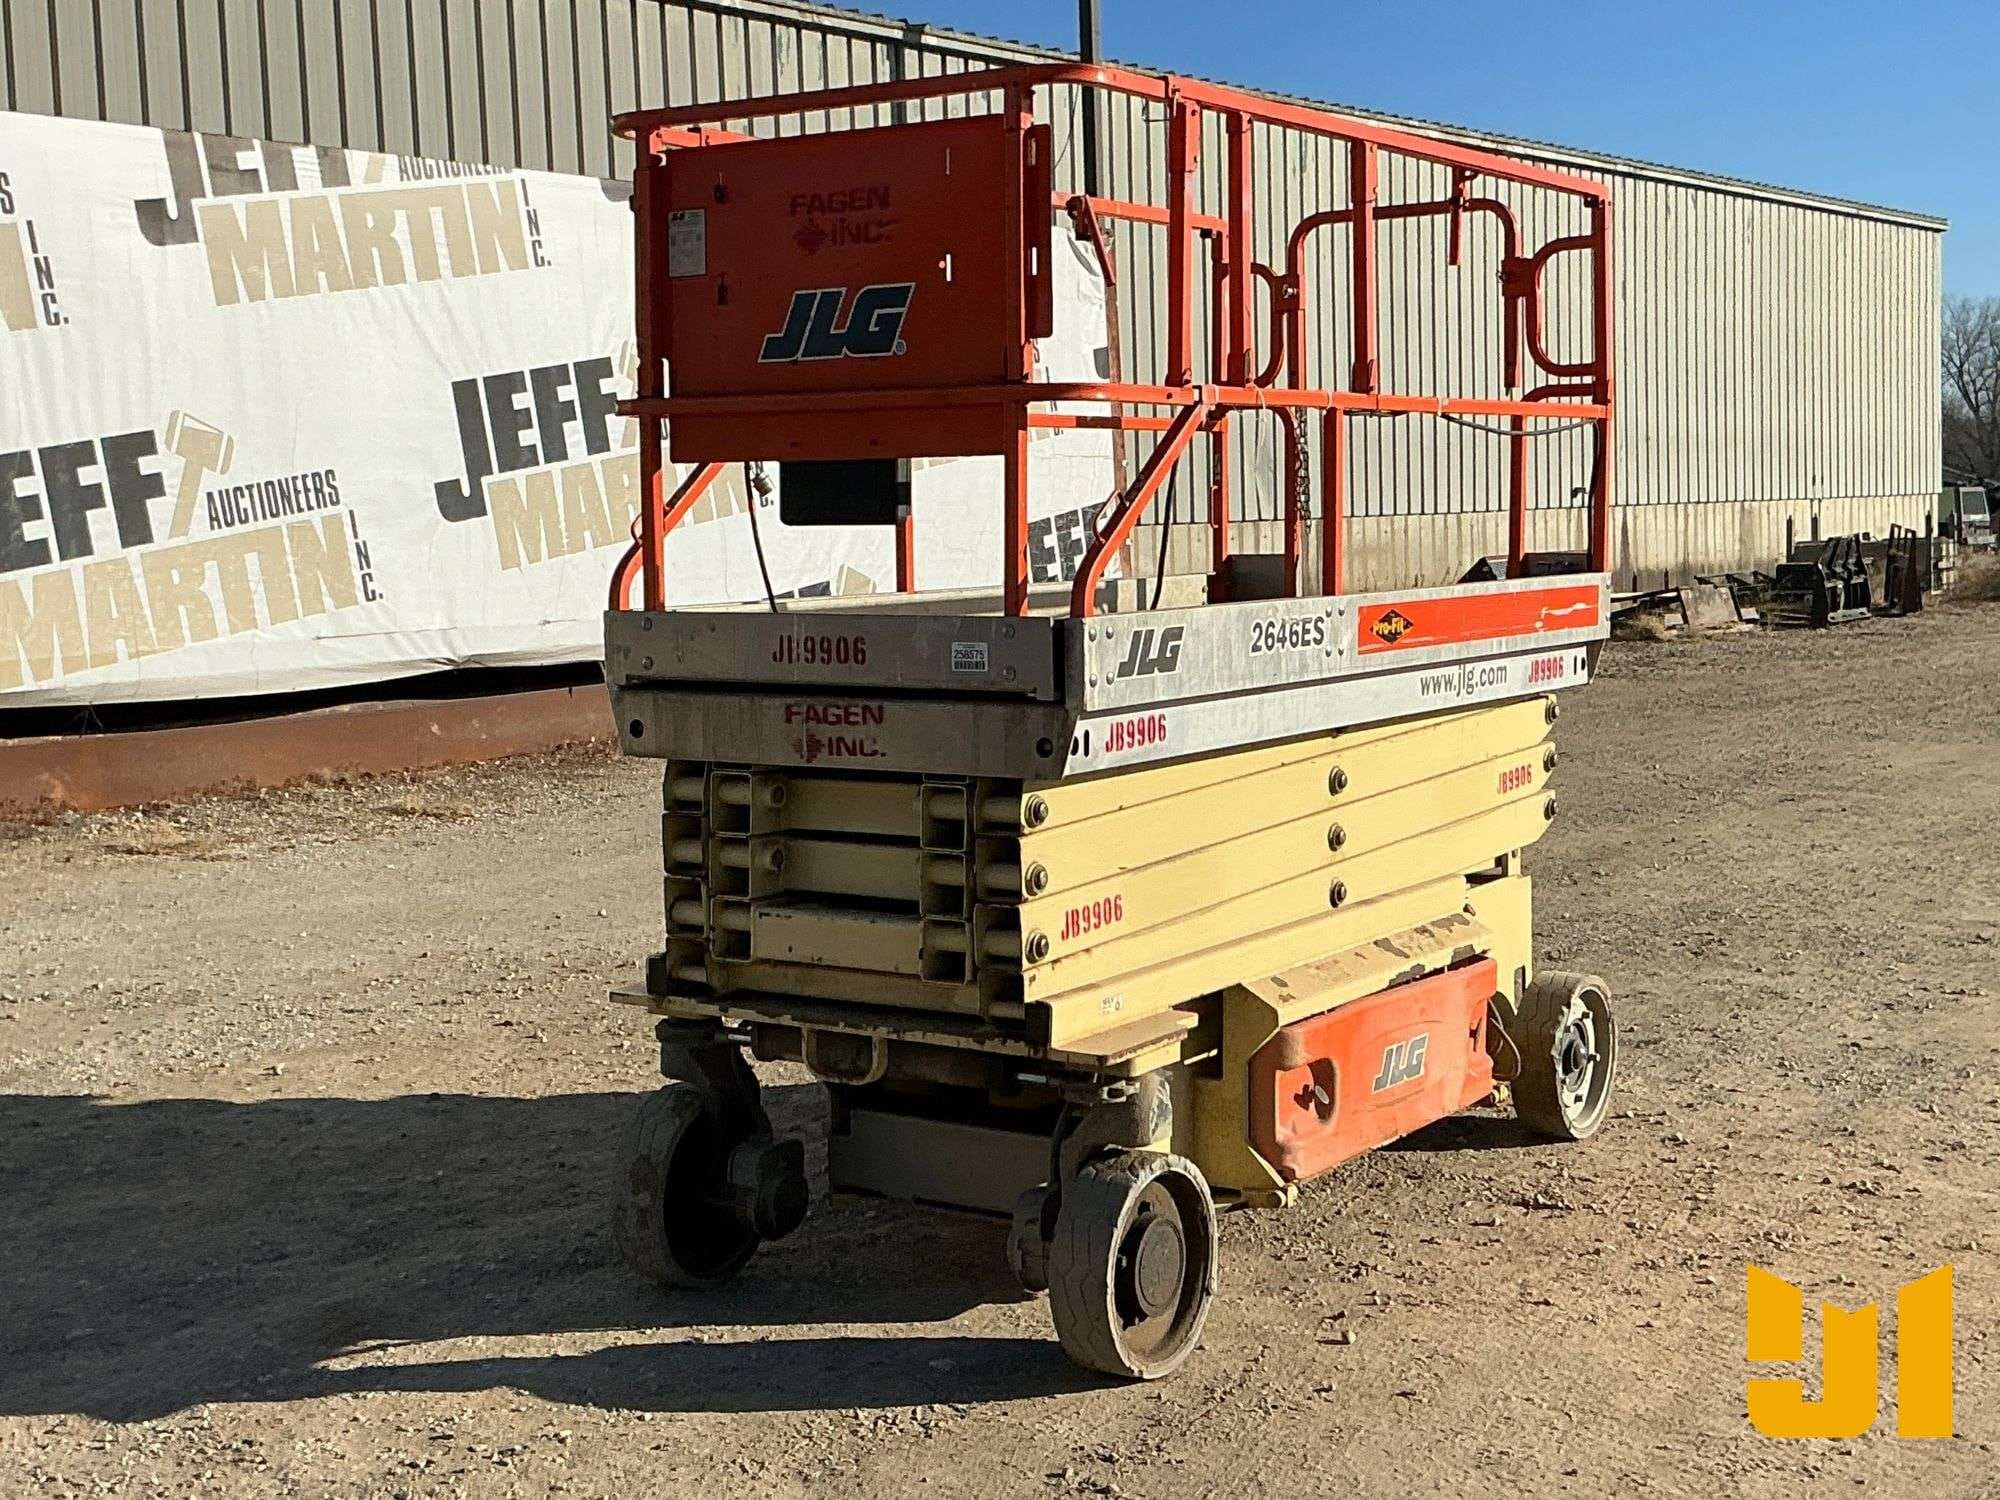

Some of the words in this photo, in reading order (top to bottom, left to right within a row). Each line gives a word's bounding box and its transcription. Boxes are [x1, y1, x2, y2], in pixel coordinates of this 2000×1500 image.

[521, 178, 552, 268] INC.
[789, 185, 890, 215] FAGEN
[199, 179, 530, 307] MARTIN
[26, 219, 70, 327] INC.
[433, 355, 619, 524] JEFF
[206, 468, 341, 531] AUCTIONEERS
[349, 508, 384, 603] INC.
[1116, 625, 1185, 679] JLG
[1251, 615, 1326, 653] 2646ES
[1420, 663, 1508, 698] www.jlg.com
[1527, 655, 1565, 684] JB9906
[783, 703, 884, 726] FAGEN
[1104, 713, 1167, 753] JB9906
[827, 736, 887, 757] INC.
[1496, 763, 1533, 795] JB9906
[1060, 893, 1123, 942] JB9906
[1371, 1032, 1429, 1094] JLG
